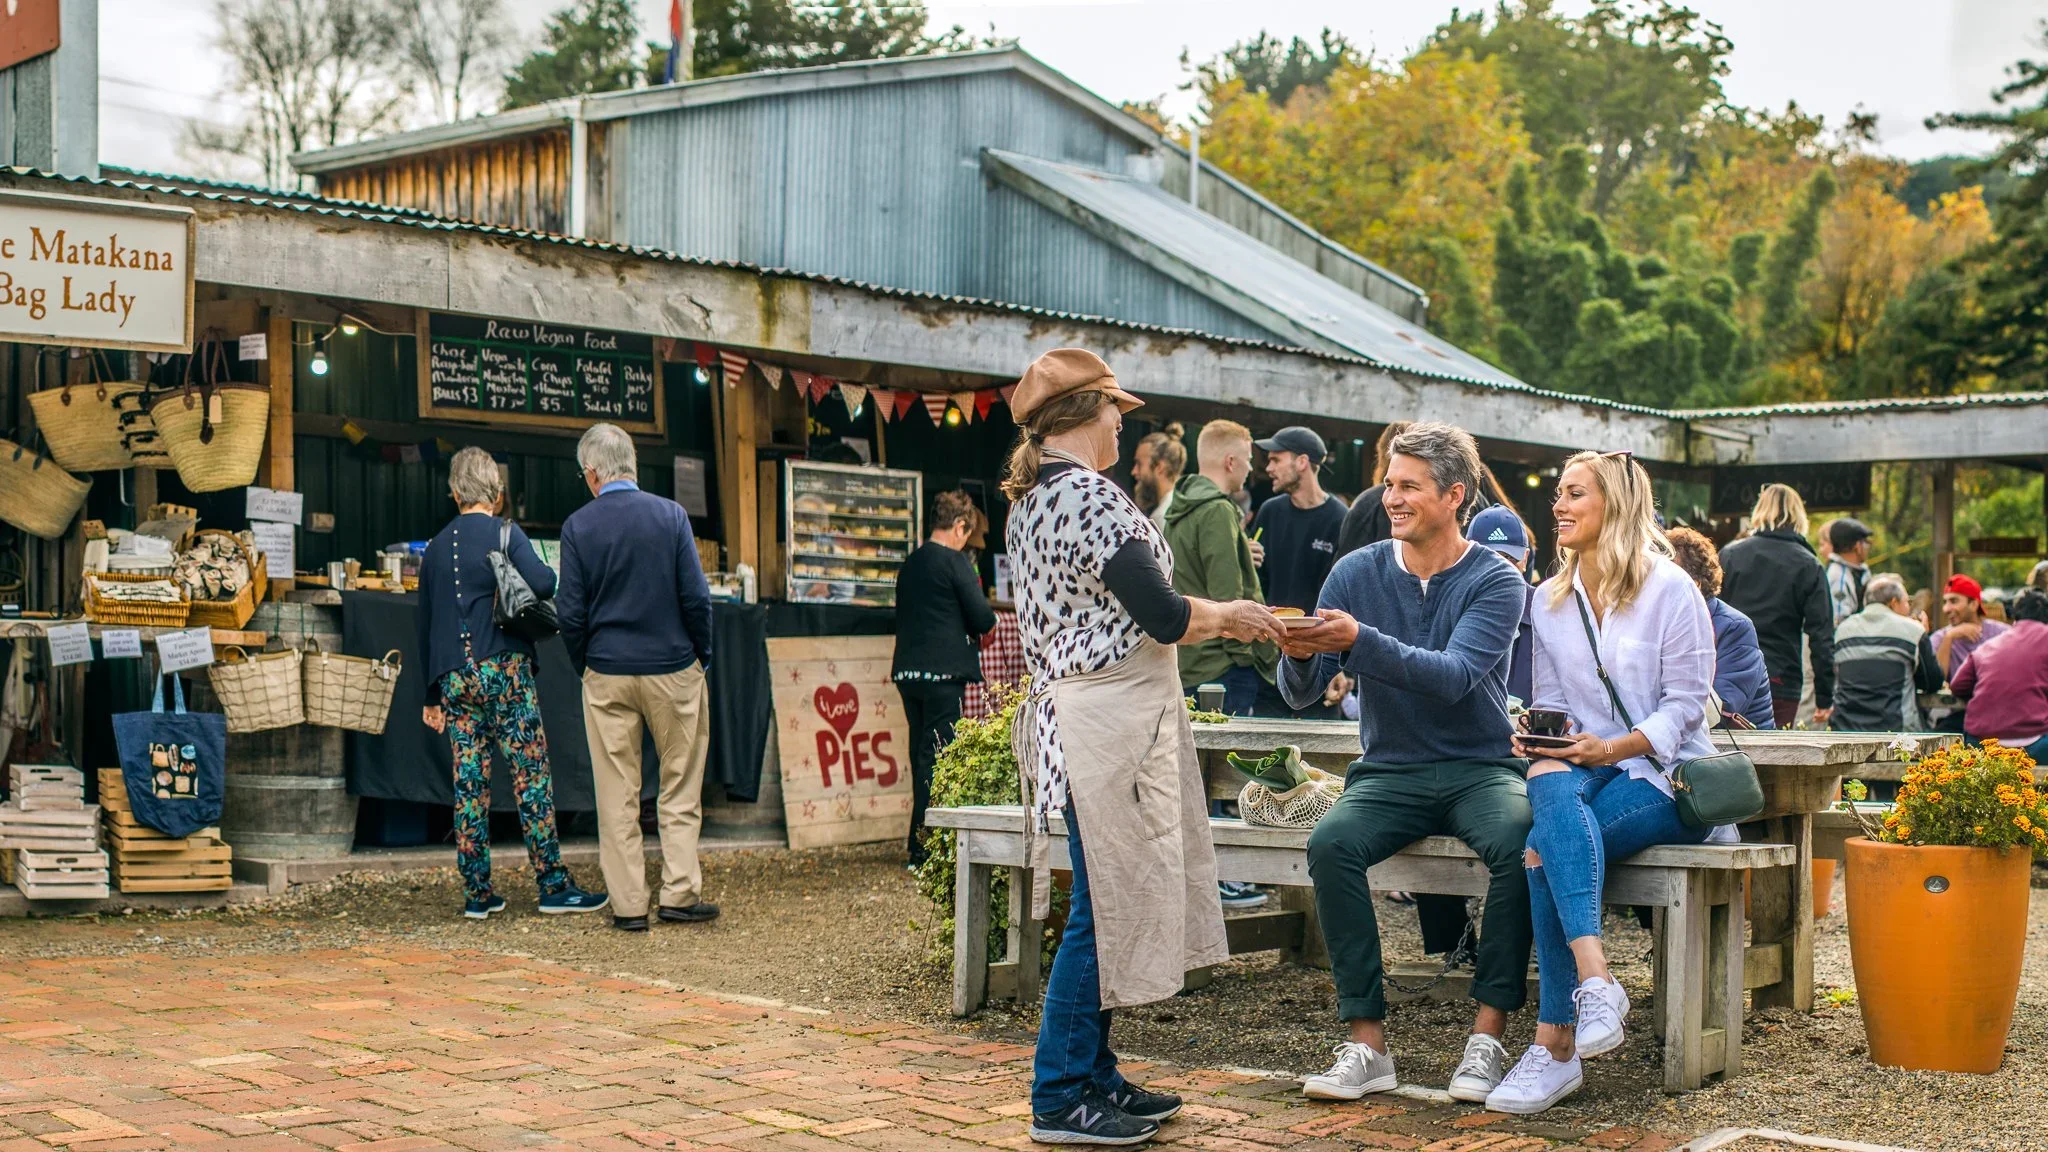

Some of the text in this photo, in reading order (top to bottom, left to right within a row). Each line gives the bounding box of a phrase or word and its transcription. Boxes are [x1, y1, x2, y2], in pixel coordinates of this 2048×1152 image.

[29, 226, 174, 271] Matakana
[61, 276, 136, 328] Lady
[486, 320, 618, 350] Raw Vegan Food
[432, 343, 466, 358] Choc
[531, 356, 558, 373] Corn
[543, 372, 573, 388] Chips
[462, 385, 479, 405] $3
[628, 399, 648, 412] $10
